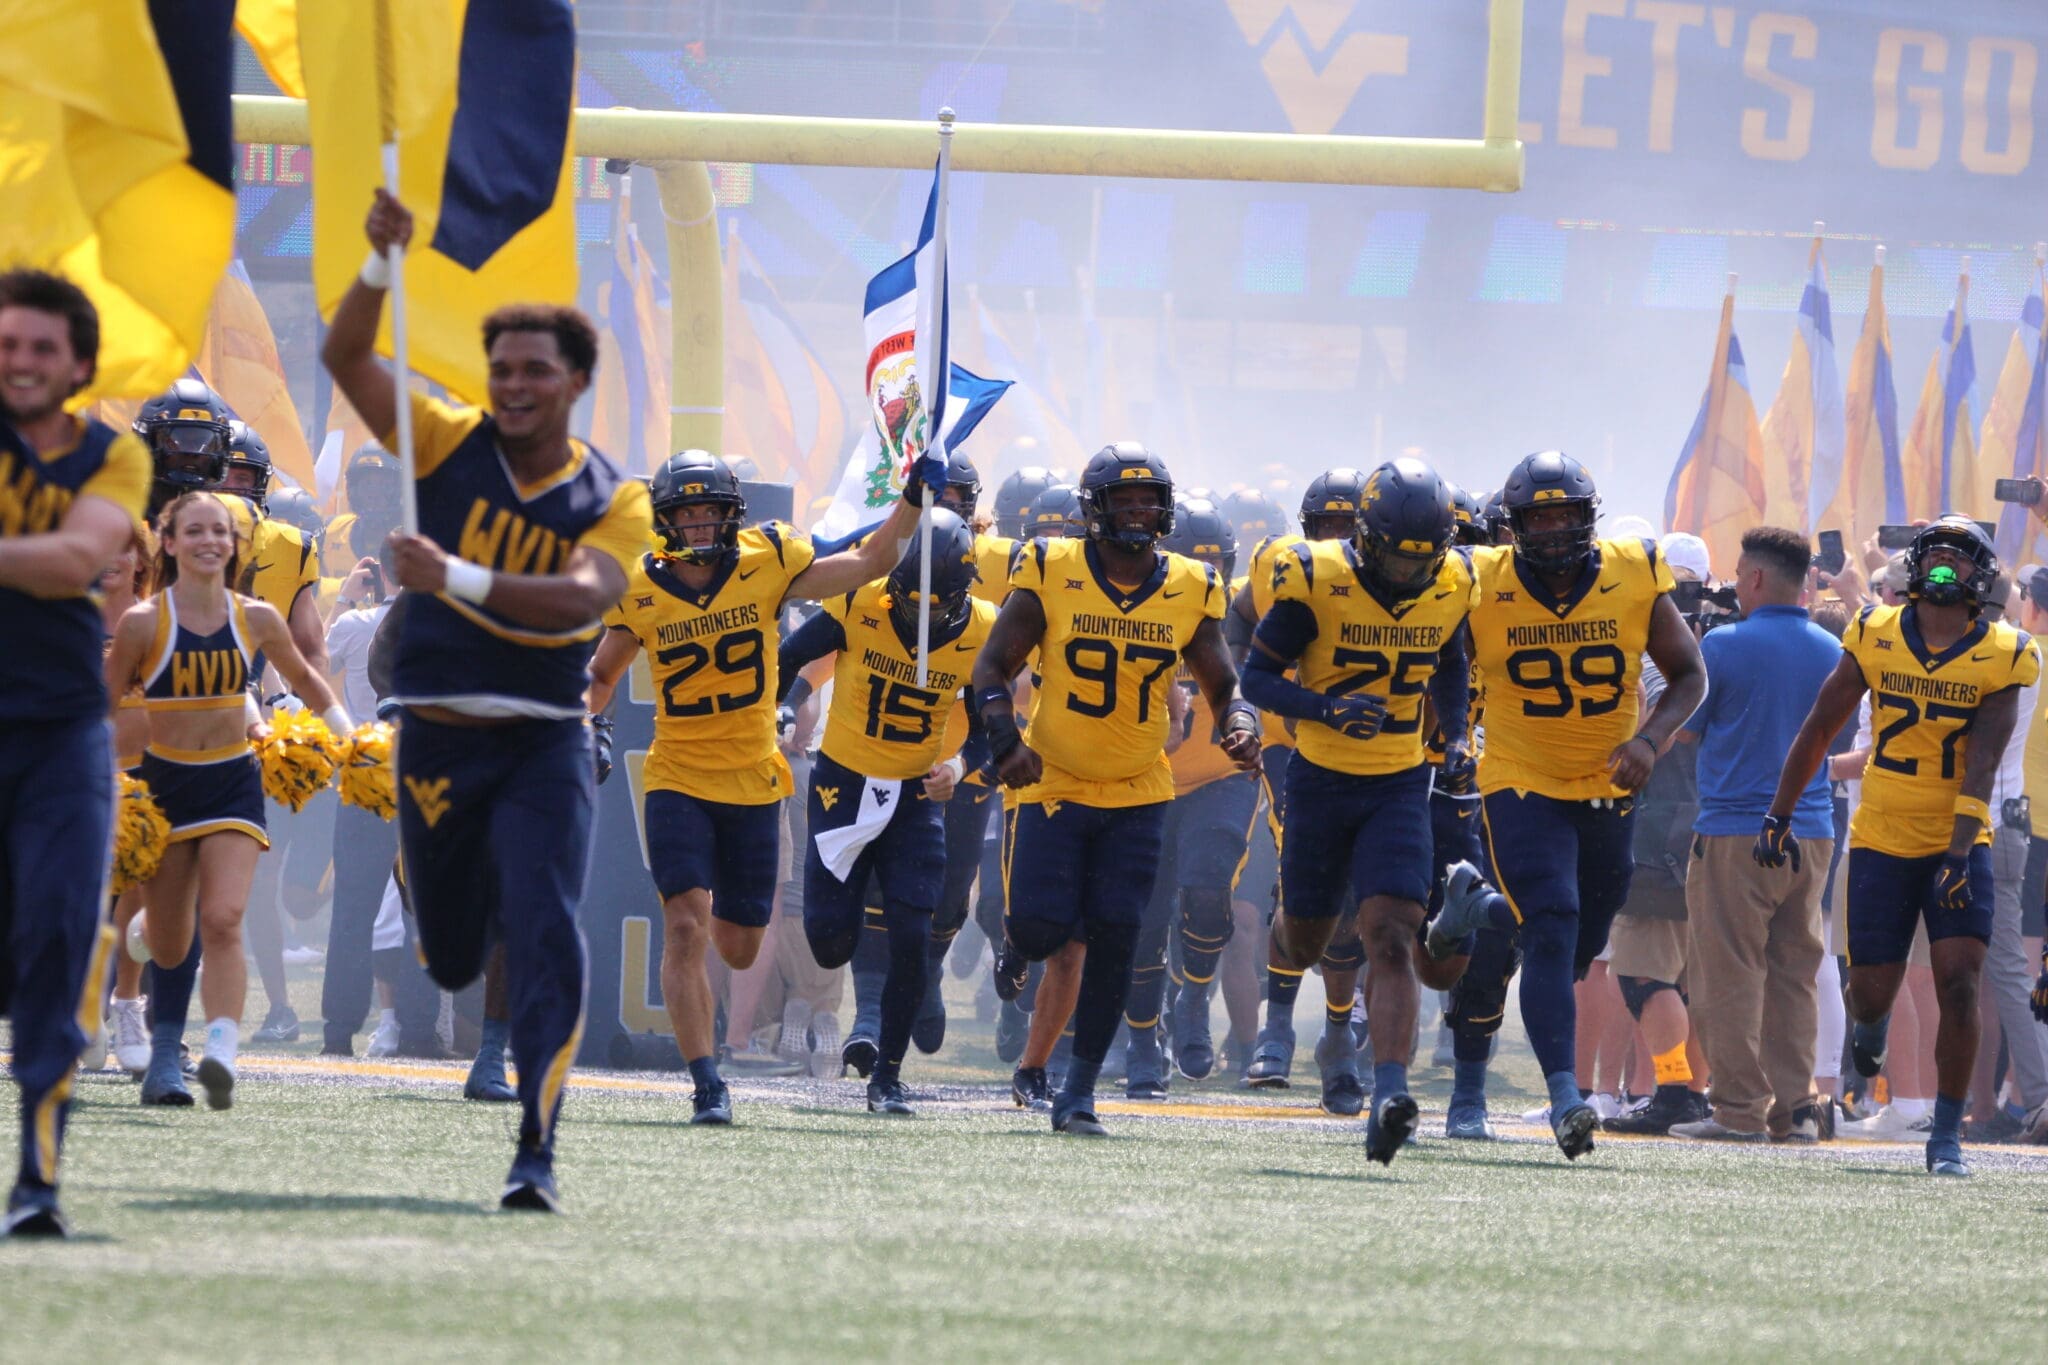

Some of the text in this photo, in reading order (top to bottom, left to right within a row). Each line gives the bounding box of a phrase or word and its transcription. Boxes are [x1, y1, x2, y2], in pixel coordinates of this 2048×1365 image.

[1490, 0, 2037, 176] ET'S GO
[656, 603, 759, 647] MOUNTAINEERS
[1071, 613, 1174, 644] MOUNTAINEERS
[1340, 622, 1443, 647] MOUNTAINEERS
[1507, 619, 1618, 647] MOUNTAINEERS
[172, 648, 243, 697] WVU
[656, 627, 765, 717] 29
[862, 648, 957, 691] MOUNTAIEERS
[1065, 637, 1178, 724] 97
[1324, 646, 1440, 735] 25
[1506, 643, 1626, 718] 99
[1880, 671, 1979, 704] MOUNTAINEERS
[865, 672, 941, 744] 15
[1873, 691, 1978, 780] 27
